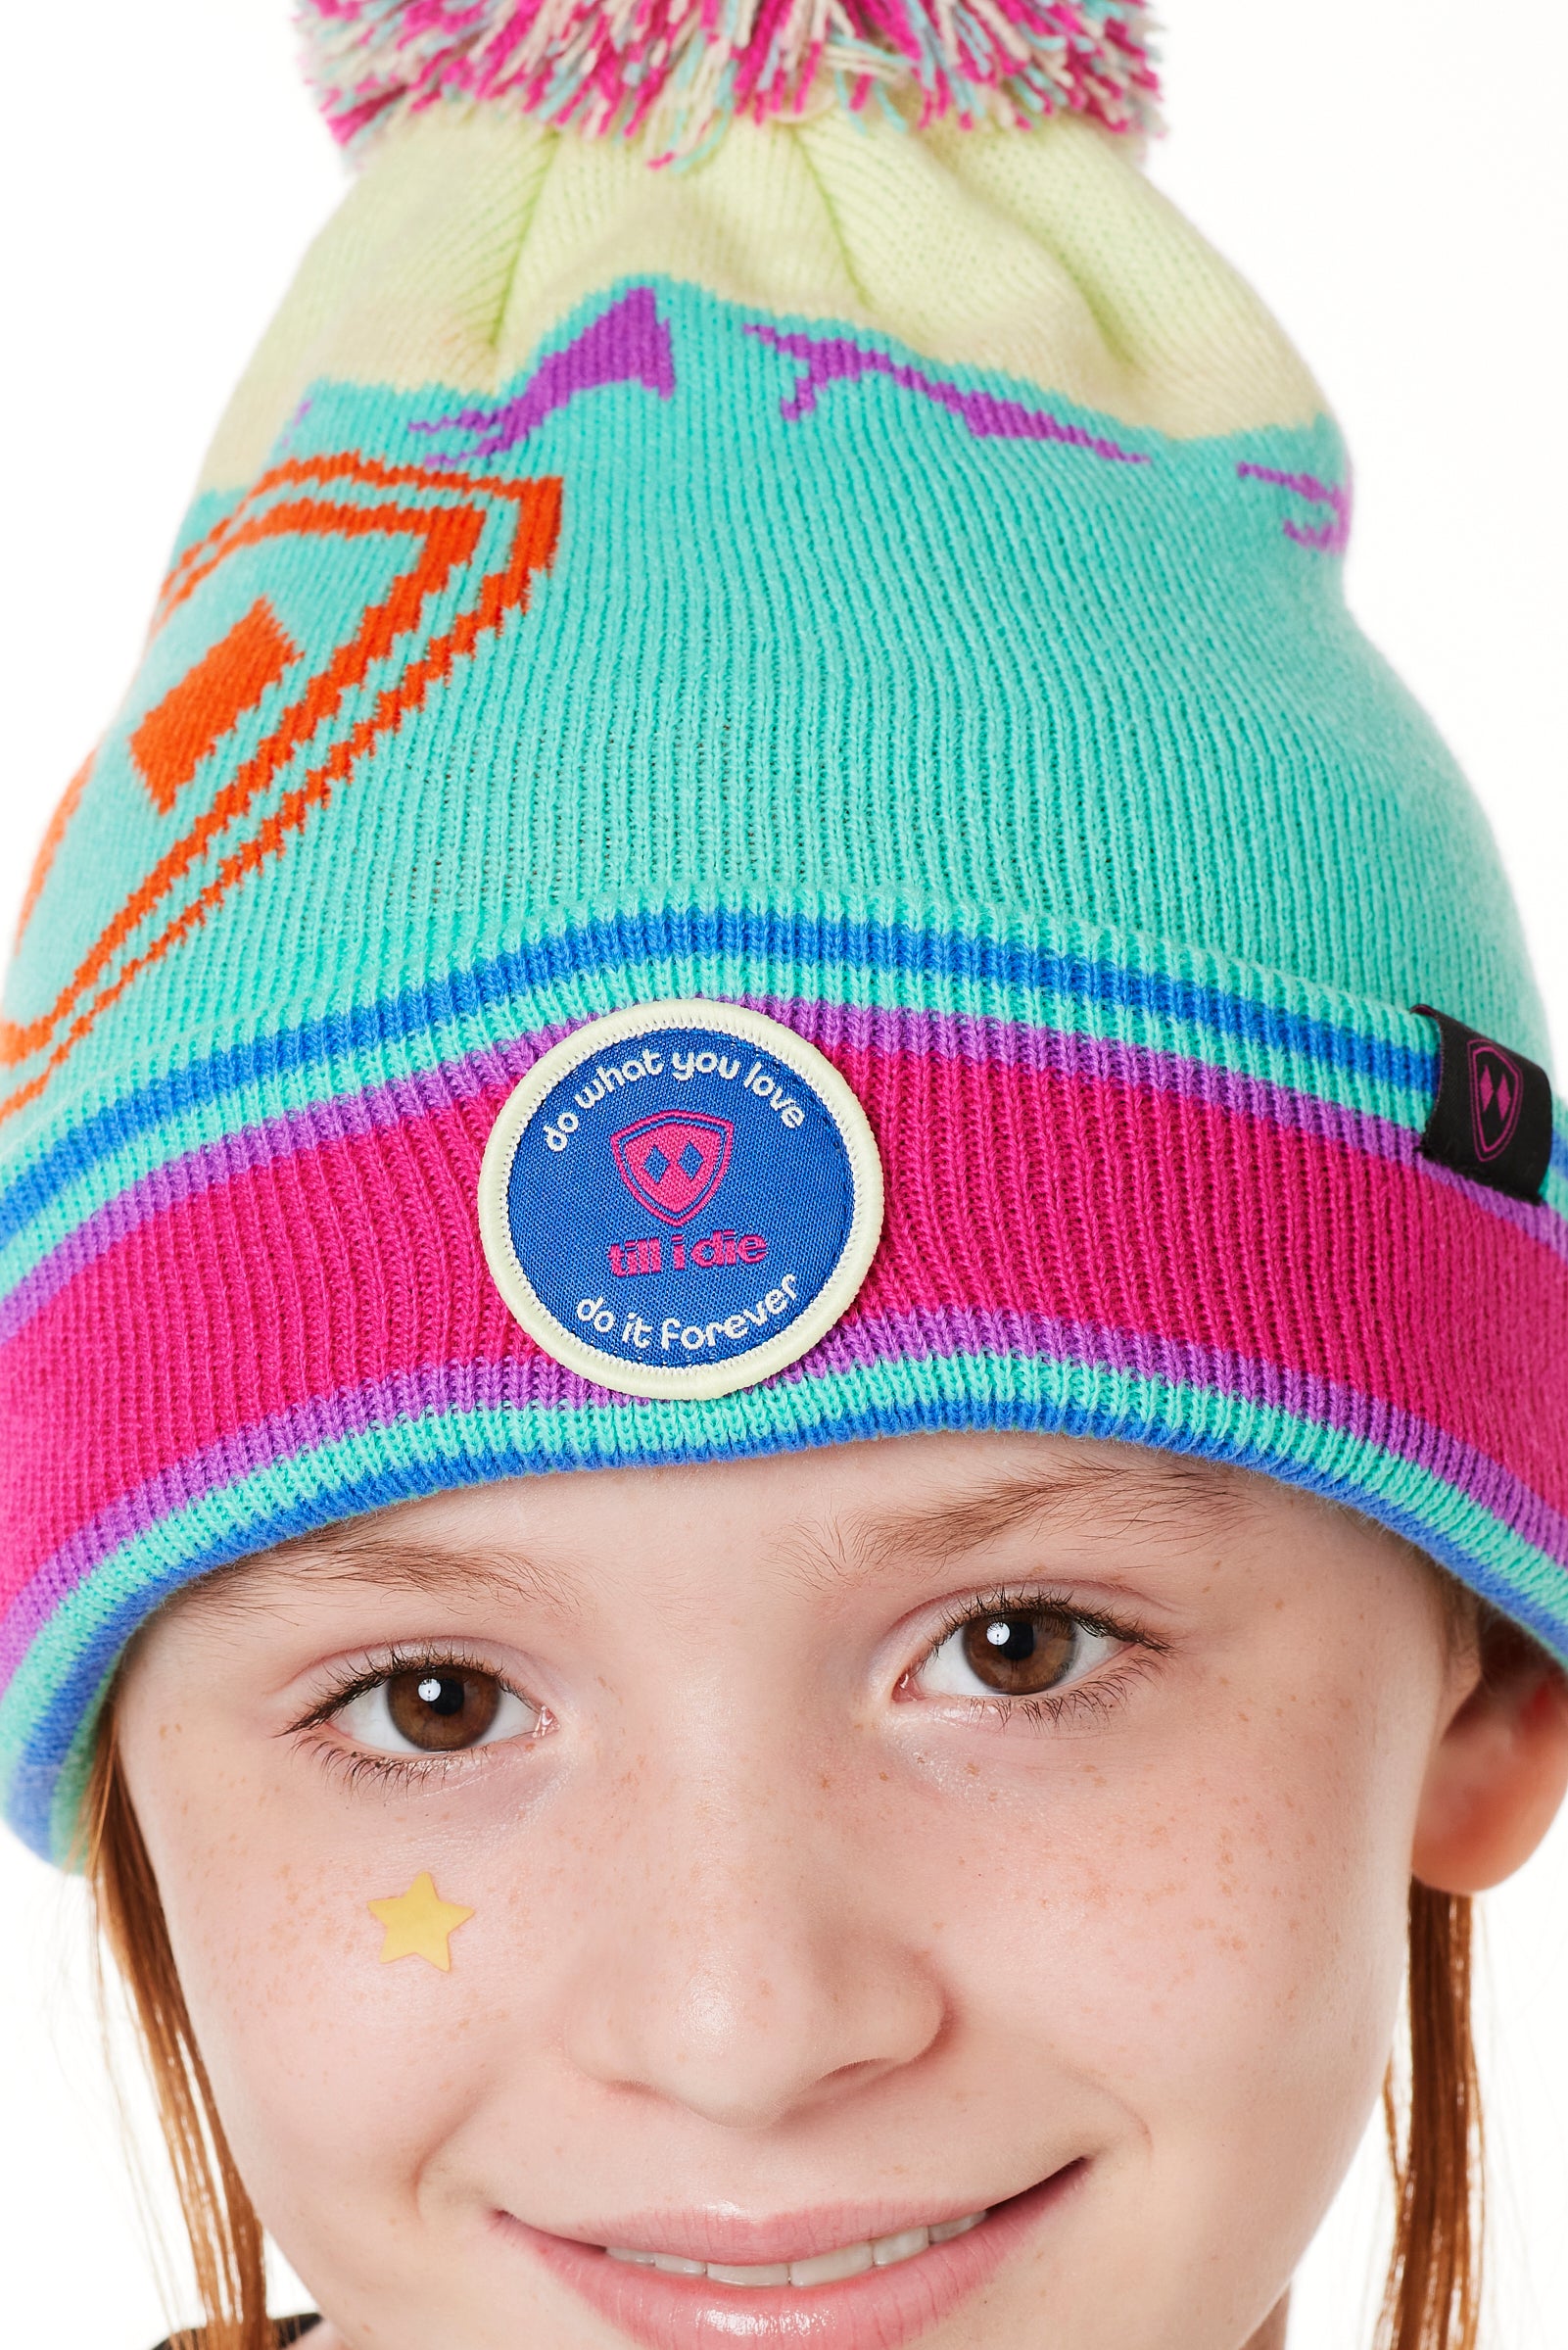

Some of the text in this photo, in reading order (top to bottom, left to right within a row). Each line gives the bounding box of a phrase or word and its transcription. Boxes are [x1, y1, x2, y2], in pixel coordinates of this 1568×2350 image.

[543, 1048, 806, 1152] do what you love
[607, 1228, 768, 1277] till i die
[576, 1296, 615, 1333] do
[622, 1312, 653, 1349] it
